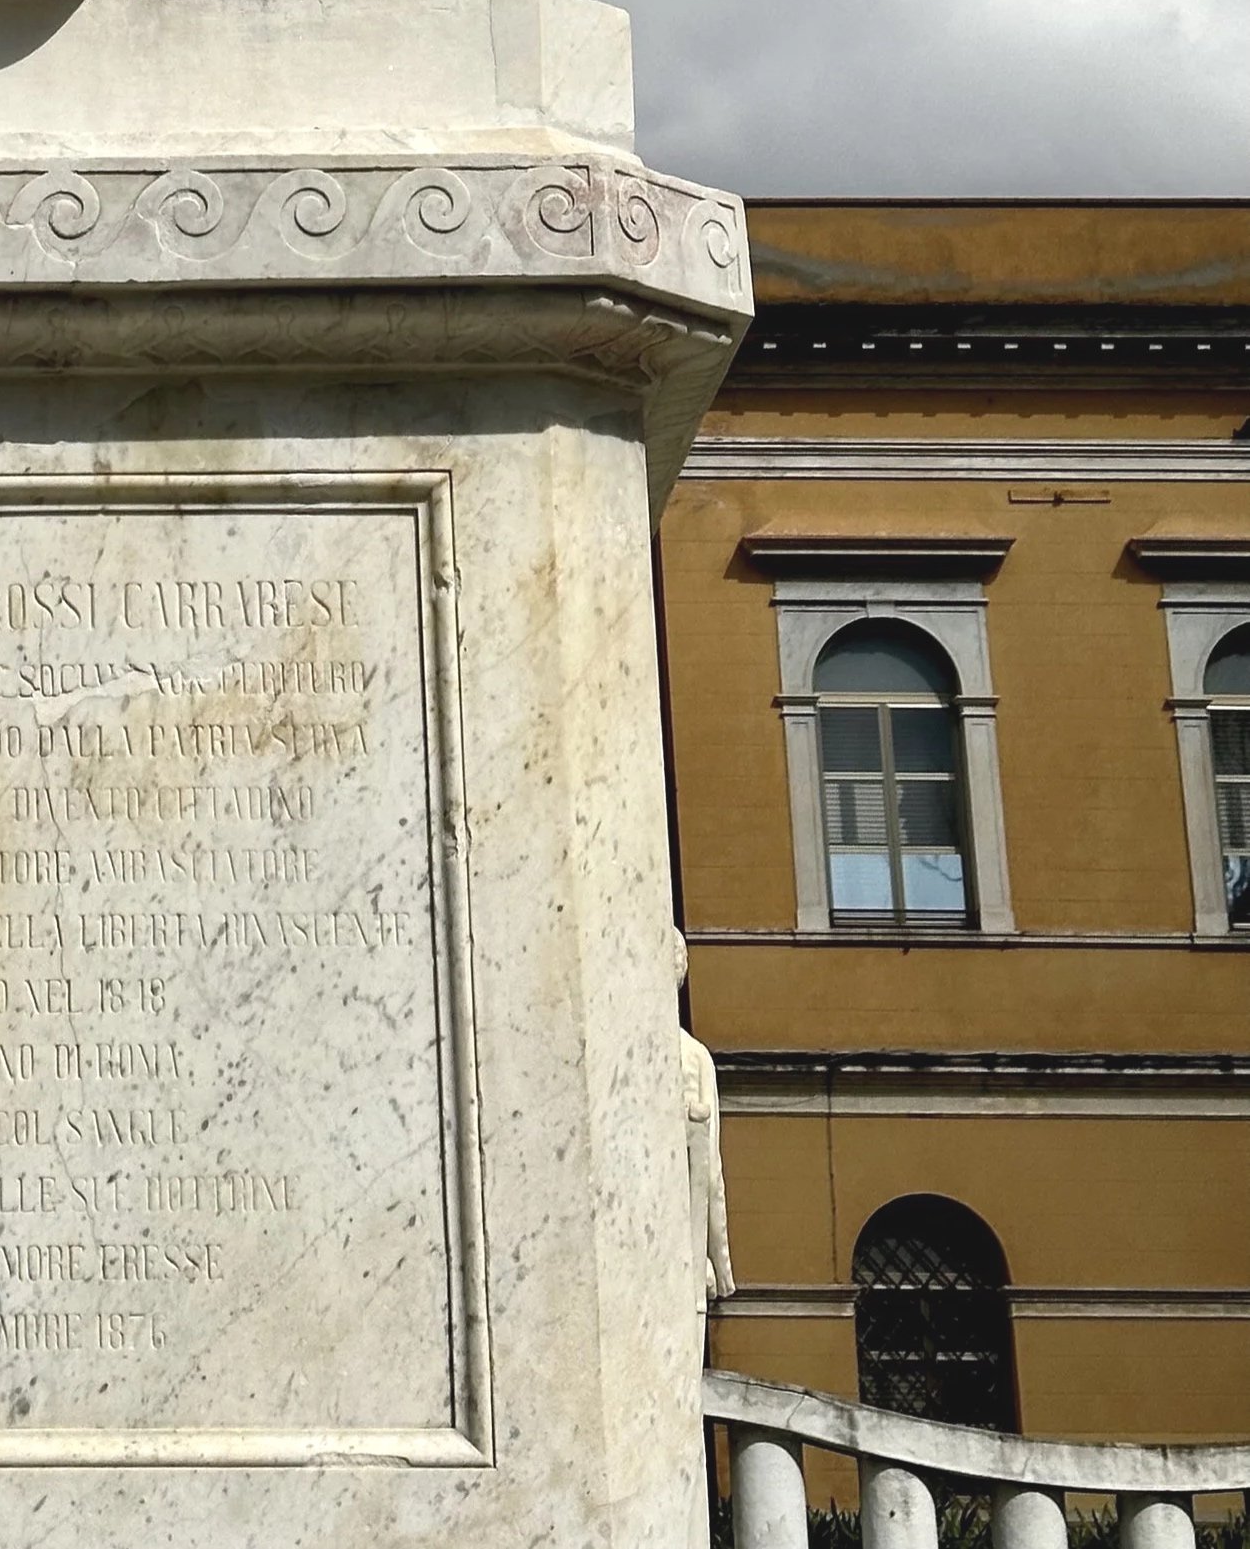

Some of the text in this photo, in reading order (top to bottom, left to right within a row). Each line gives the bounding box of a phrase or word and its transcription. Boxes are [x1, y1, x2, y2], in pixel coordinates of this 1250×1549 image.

[123, 579, 359, 629] CARRARESE
[38, 724, 133, 758] DALLA
[150, 724, 255, 758] PATRIA
[156, 785, 313, 822] CITTADINO
[90, 849, 318, 884] AMBASCIATORE
[223, 911, 410, 947] RINASCENTE
[25, 978, 83, 1014] NEL
[54, 1043, 82, 1080] DI
[96, 1043, 181, 1080] ROMA
[66, 1108, 189, 1146] SANGUE
[71, 1176, 126, 1212] SUE
[145, 1175, 300, 1212] DOTTRINE
[100, 1243, 224, 1282] ERESSE
[97, 1312, 167, 1350] 1876
